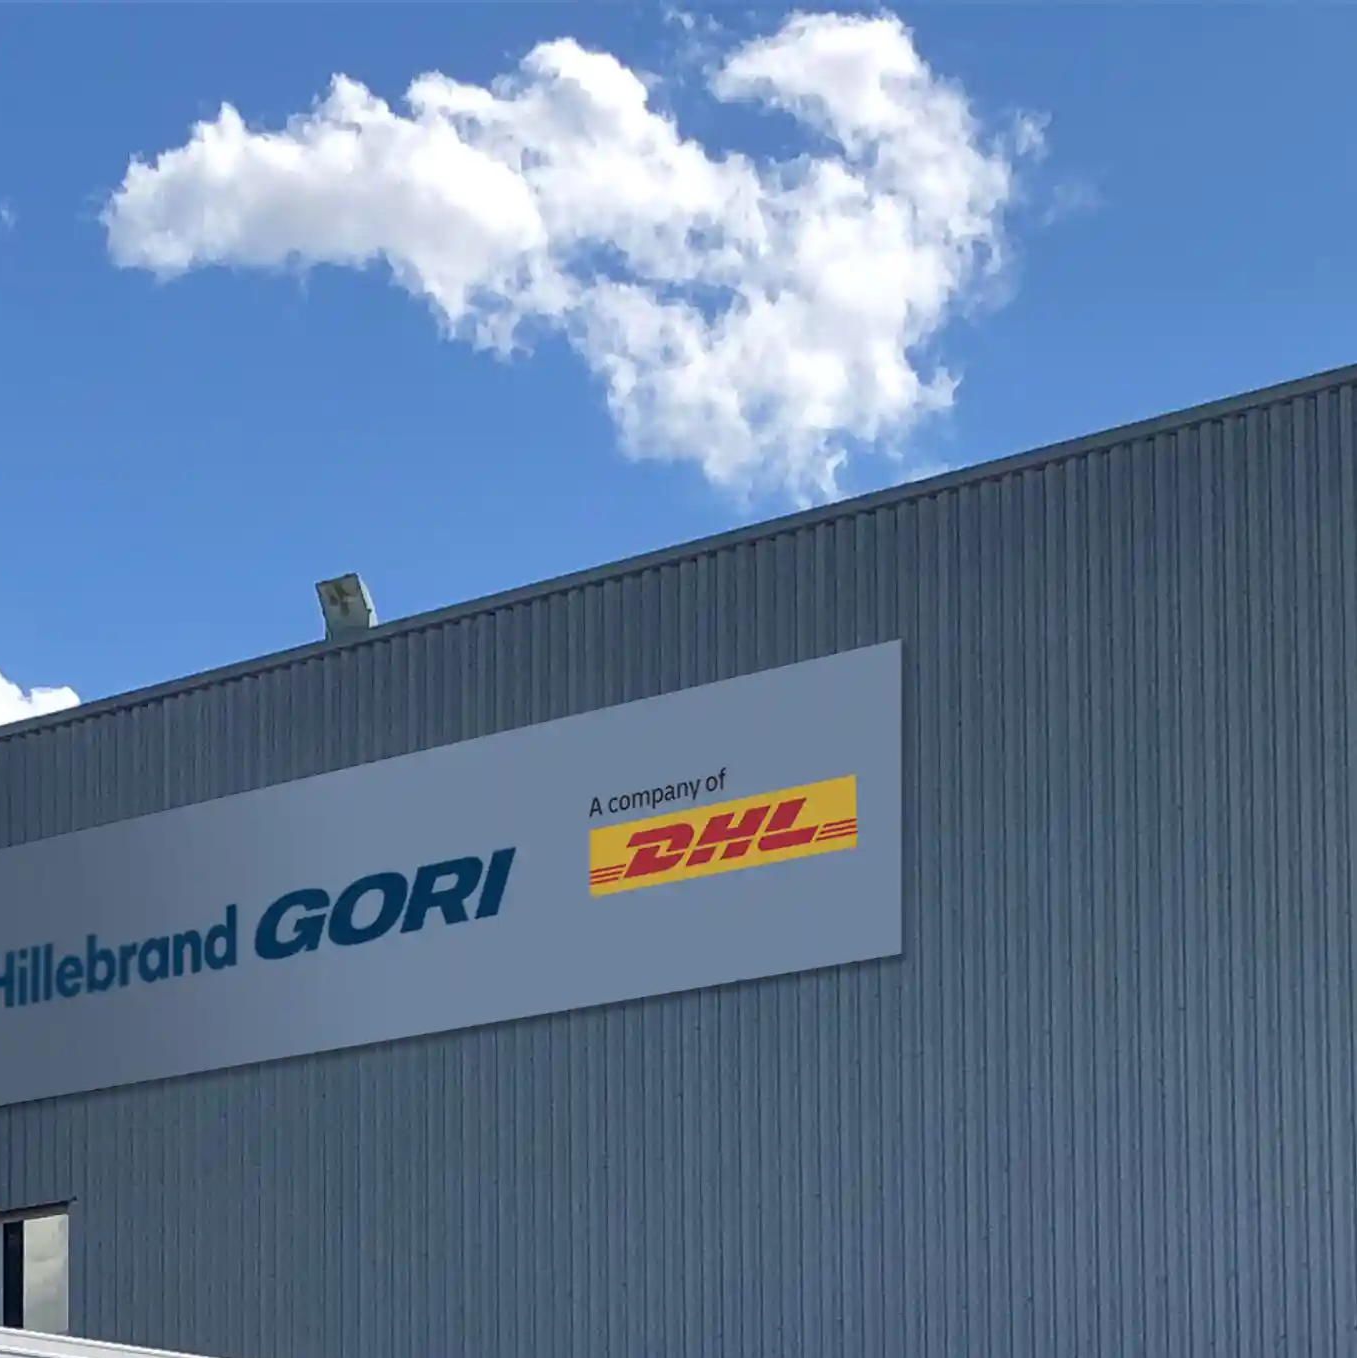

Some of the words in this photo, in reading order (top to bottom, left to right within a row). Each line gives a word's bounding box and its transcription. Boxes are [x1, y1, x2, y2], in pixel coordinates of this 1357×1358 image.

[589, 797, 603, 818] A
[608, 778, 702, 814] company
[705, 767, 727, 791] of
[623, 797, 819, 879] DHL
[254, 846, 517, 960] GORI
